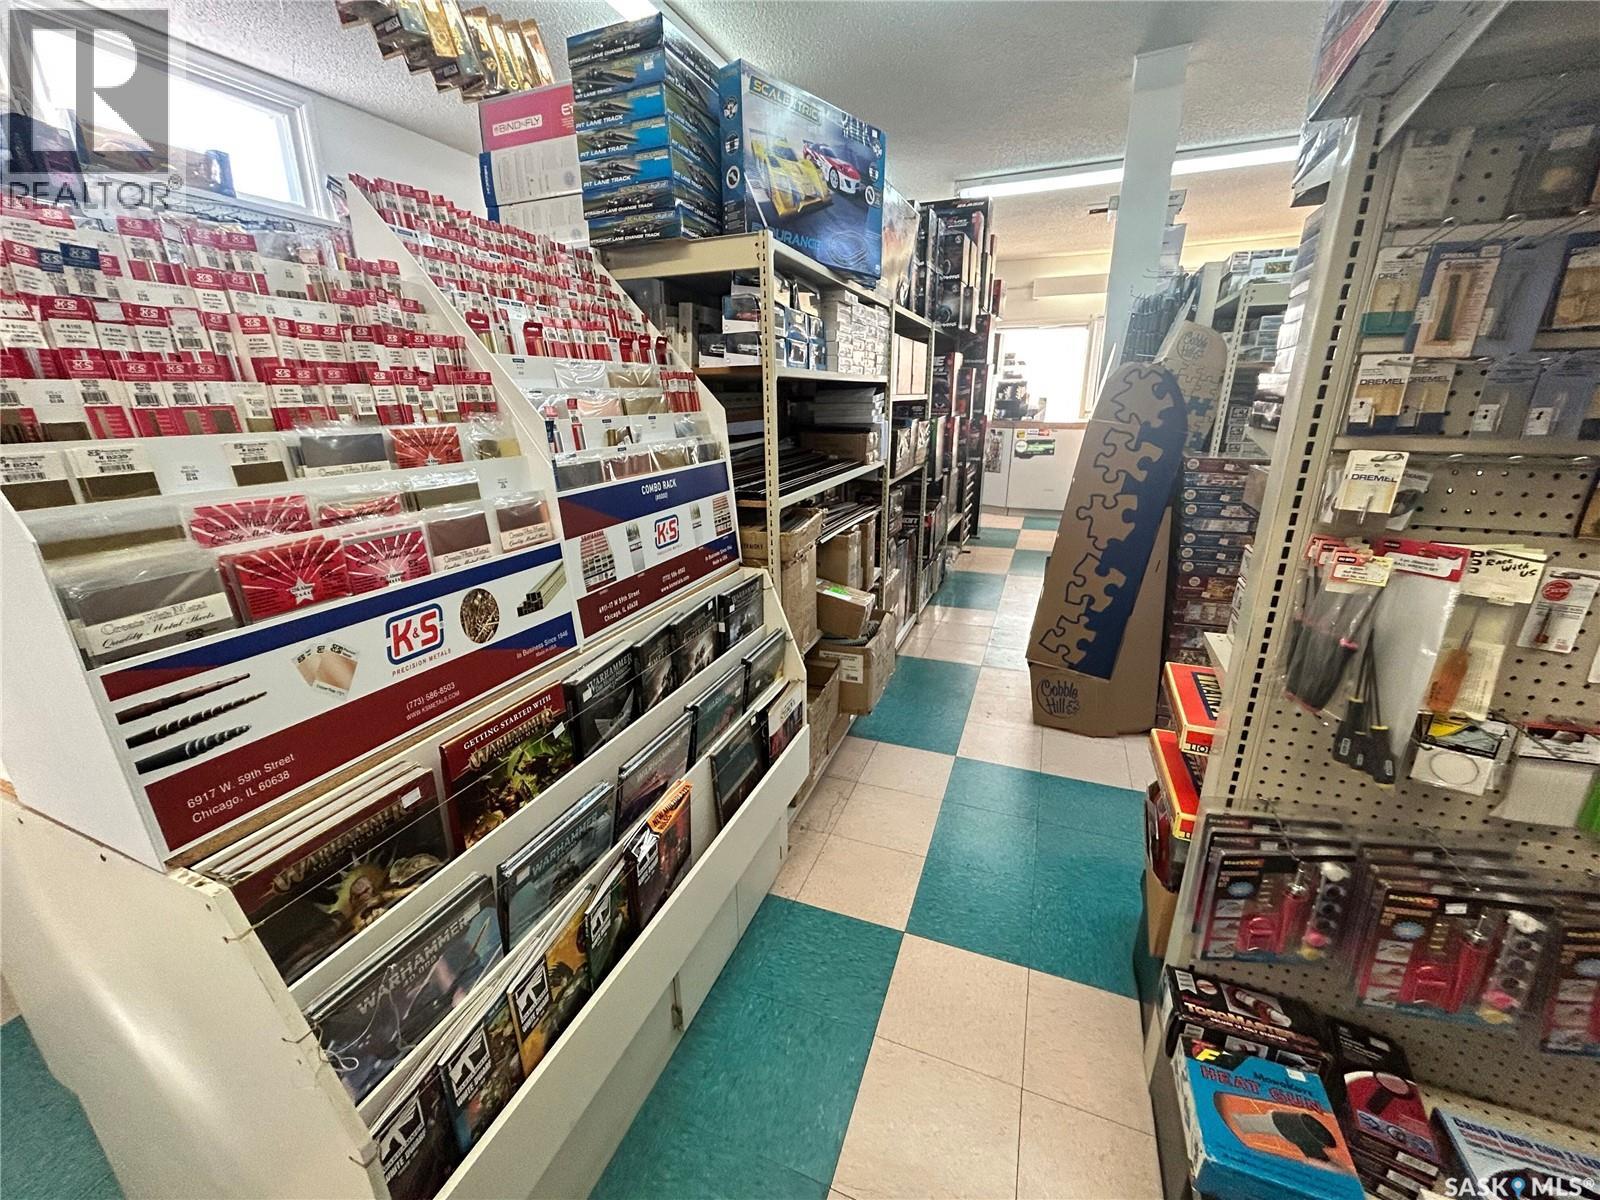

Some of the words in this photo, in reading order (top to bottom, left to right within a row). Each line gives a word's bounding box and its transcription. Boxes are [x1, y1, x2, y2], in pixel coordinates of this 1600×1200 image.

[583, 90, 597, 98] LANE
[598, 87, 613, 95] TRACK
[575, 121, 585, 130] PIT
[586, 118, 602, 128] LANE
[603, 114, 623, 124] TRACK
[591, 147, 607, 156] LANE
[607, 143, 629, 153] TRACK
[594, 178, 610, 186] LANE
[611, 175, 631, 184] TRACK
[644, 231, 660, 239] TRACK
[1360, 377, 1405, 386] DREMEL
[641, 480, 662, 496] COMBO
[662, 478, 677, 491] RACK
[1352, 473, 1397, 483] DREMEL
[656, 522, 677, 545] K&S
[102, 631, 143, 648] Quality
[153, 620, 184, 635] Metal
[185, 611, 216, 625] Sheets
[391, 610, 441, 658] K&S
[516, 652, 523, 660] In
[522, 643, 543, 658] Business
[543, 636, 557, 651] Since
[392, 655, 428, 678] PRECISION
[586, 652, 633, 692] WARHAMMER
[406, 694, 424, 711] (773)
[425, 681, 456, 702] 586-8503
[1041, 679, 1079, 699] Cobble
[1046, 698, 1065, 714] Hill
[463, 723, 500, 751] GETTING
[500, 705, 533, 730] STARTED
[533, 694, 552, 709] WITH
[187, 788, 216, 809] 6917
[218, 777, 236, 794] W.
[237, 764, 263, 787] 59th
[263, 753, 295, 774] Street
[192, 793, 244, 824] Chicago,
[246, 784, 257, 798] IL
[258, 770, 291, 792] 60638
[532, 810, 599, 876] WARHAMMER
[356, 917, 470, 1015] WARHAMMER
[1200, 1065, 1261, 1095] HEAT
[1268, 1087, 1324, 1115] GUN
